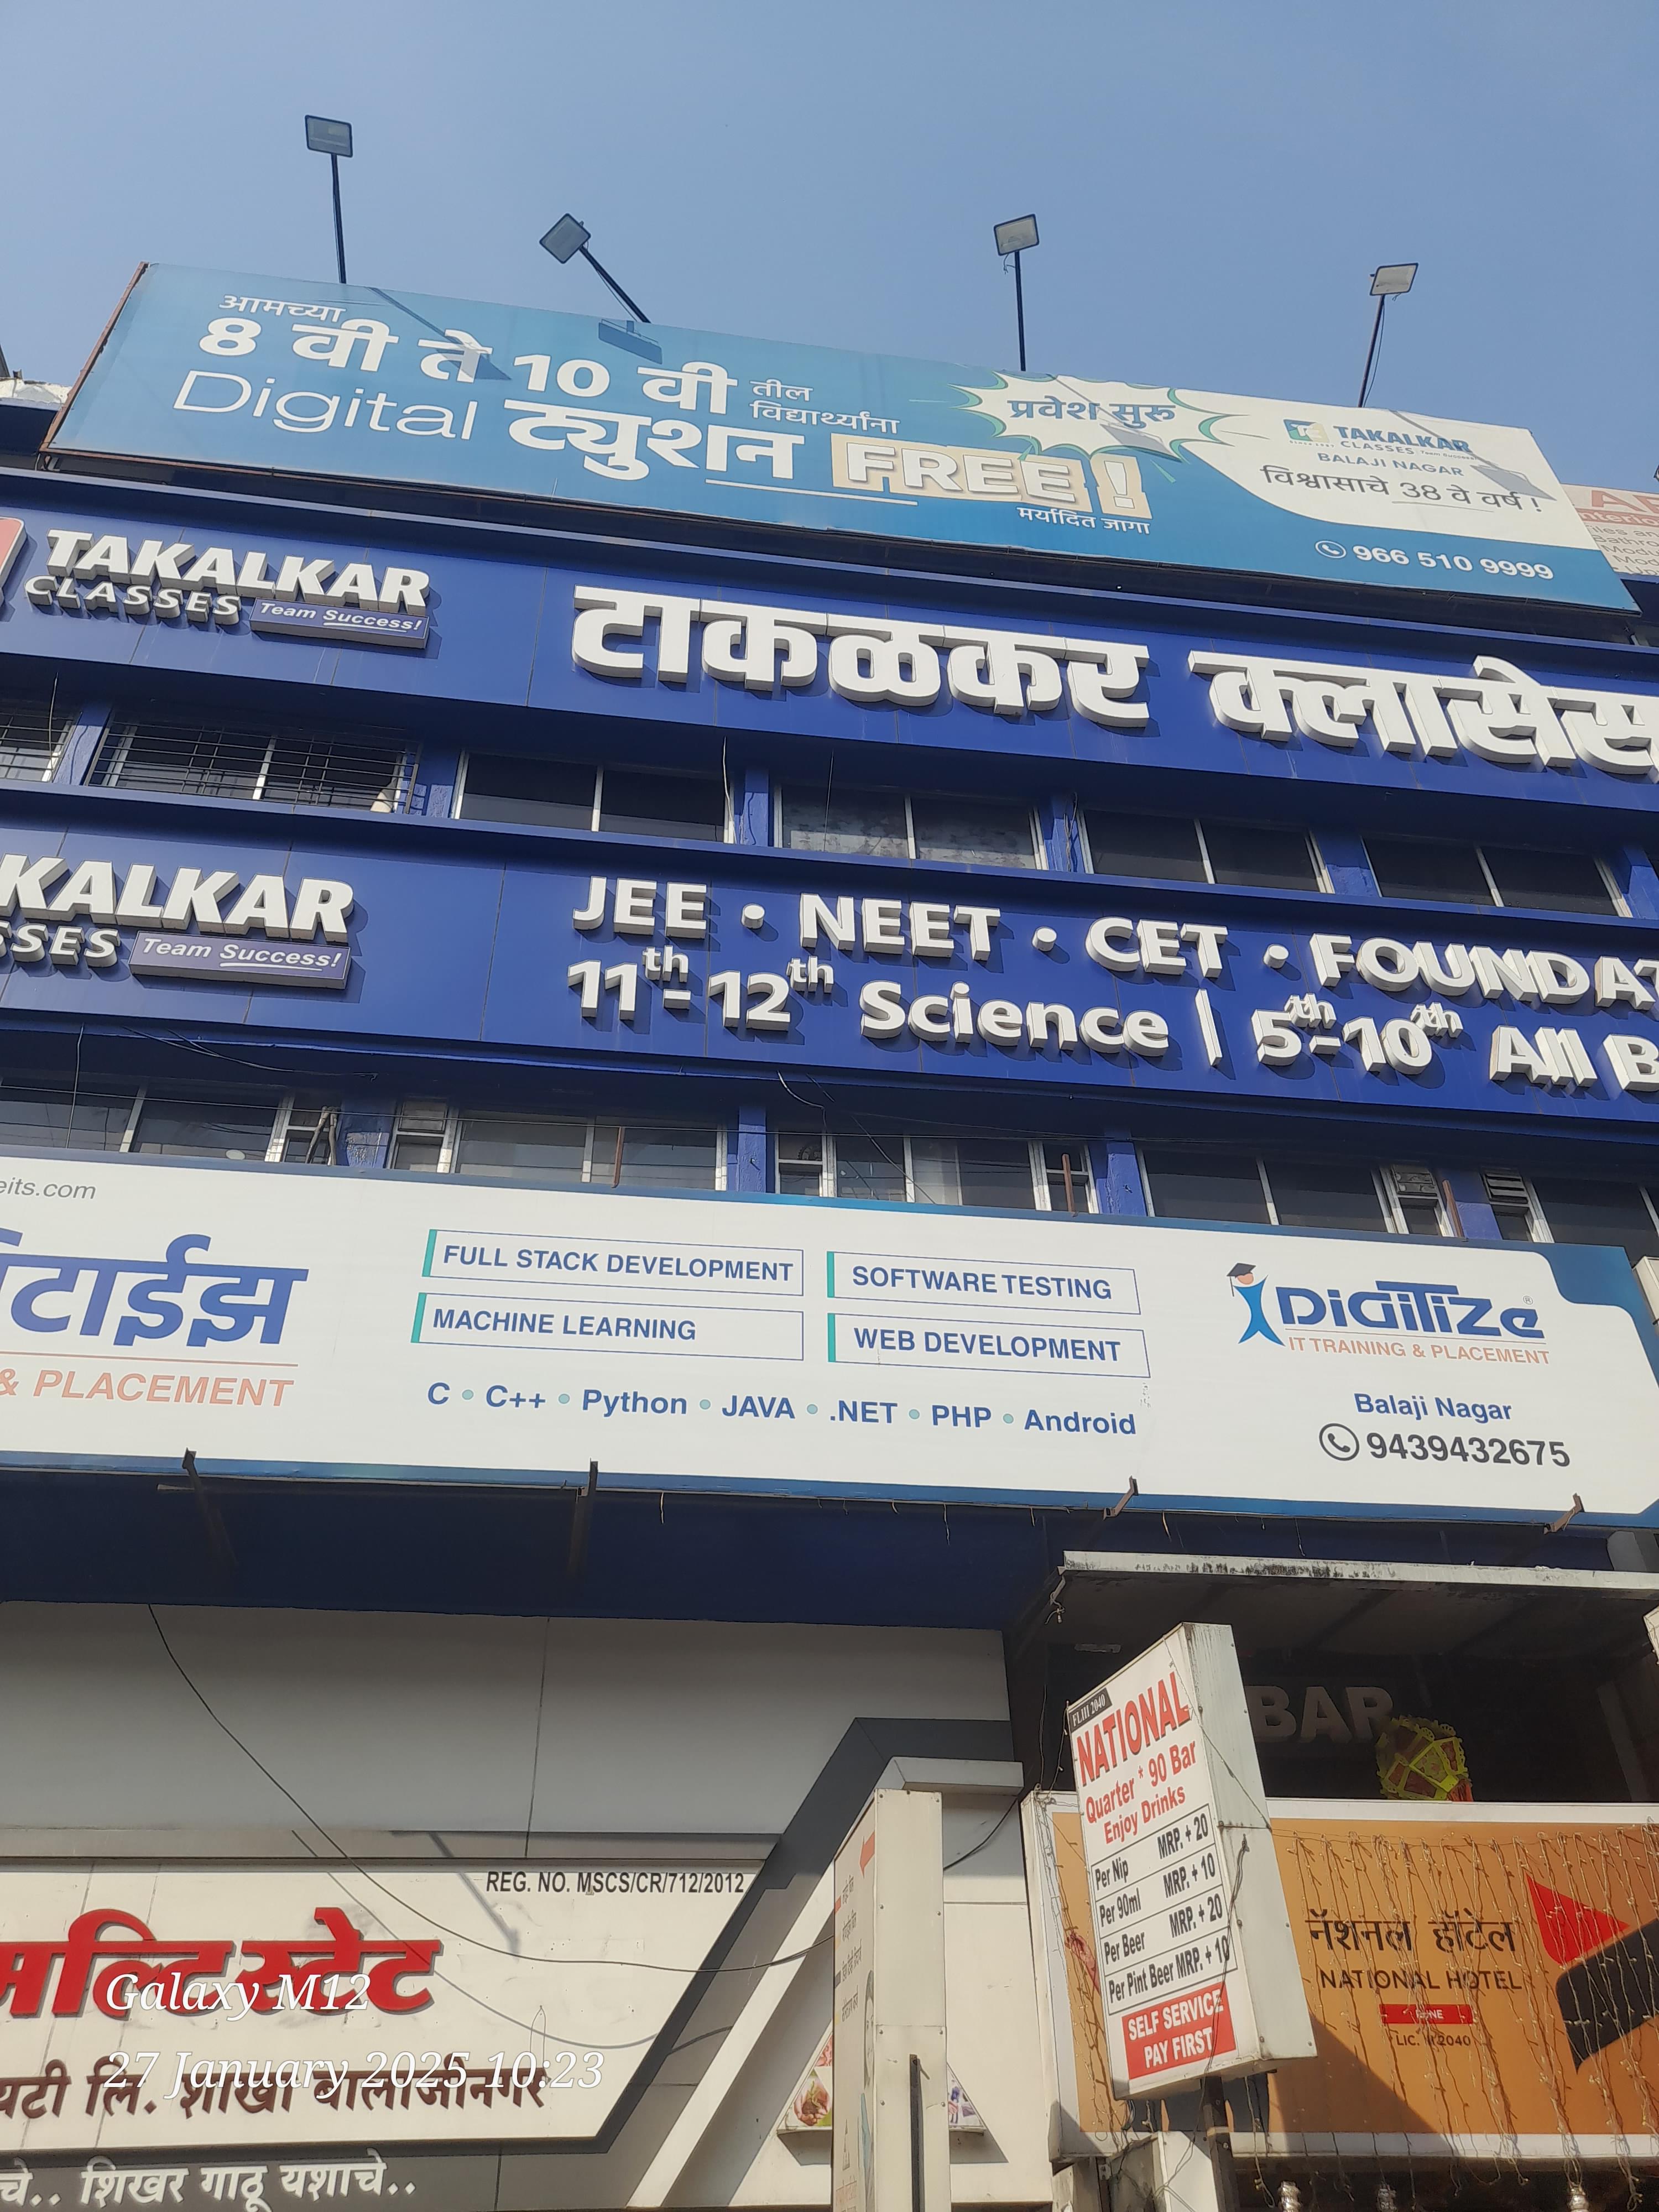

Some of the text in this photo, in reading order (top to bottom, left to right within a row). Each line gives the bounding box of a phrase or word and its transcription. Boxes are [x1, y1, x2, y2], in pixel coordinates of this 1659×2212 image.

[219, 295, 347, 322] आमच्या
[199, 317, 737, 414] 8 वी ते 10 वी
[750, 379, 812, 401] तील
[1008, 396, 1099, 420] प्रवेश
[173, 369, 477, 440] Digital
[504, 399, 805, 481] ट्युशन
[1333, 425, 1473, 453] TAKALKAR
[1318, 453, 1464, 476] BALAJI NAGAR
[1340, 441, 1414, 455] CLASSES
[1260, 465, 1389, 496] विश्वासाचे
[1400, 482, 1441, 500] 38
[1447, 485, 1470, 504] वे
[1477, 490, 1522, 510] वर्ष
[1018, 508, 1149, 534] मर्यादित जागा
[1585, 525, 1628, 535] iles
[46, 529, 429, 614] TAKALKAR
[1353, 545, 1553, 580] 966 510 9999
[24, 575, 240, 625] CLASSES
[260, 602, 422, 631] Team Success!
[572, 584, 1149, 727] टाकळकर
[572, 875, 707, 940] JEE
[800, 893, 1000, 961] NEET
[1085, 916, 1228, 978] CET
[142, 938, 342, 968] Team Success!
[859, 980, 1168, 1057] Science
[1490, 1025, 1597, 1087] All
[444, 1245, 793, 1281] FULL STACK DEVELOPMENT
[853, 1266, 1111, 1300] SOFTWARE TESTING
[433, 1308, 696, 1340] MACHINE LEARNING
[854, 1328, 1120, 1361] WEB DEVELOPMENT
[1288, 1337, 1549, 1365] IT TRAINING & PLACEMENT
[33, 1369, 294, 1407] PLACEMENT
[427, 1383, 1136, 1434] C C++ Python JAVA .NET PHP Android
[1354, 1392, 1511, 1424] Balaji Nagar
[1366, 1432, 1570, 1467] 9439432675
[1090, 1694, 1105, 1713] 2040
[1244, 1685, 1394, 1743] BAR
[1077, 1671, 1190, 1787] NATIONAL
[1086, 1740, 1196, 1823] Quarter 90 Bar
[1104, 1785, 1186, 1844] Enjoy Drinks
[1095, 1868, 1110, 1891] Per
[1112, 1857, 1129, 1883] Nip
[1157, 1827, 1183, 1859] MRP.
[1193, 1813, 1208, 1841] 20
[486, 1872, 744, 1893] REG. NO. MSCS/CR/712/2012
[1099, 1905, 1115, 1927] Per
[1117, 1887, 1141, 1919] 90ml
[1163, 1866, 1190, 1898] MRP.
[1201, 1853, 1215, 1880] 10
[1104, 1942, 1119, 1964] Per
[1122, 1932, 1145, 1957] Beer
[1169, 1906, 1196, 1938] MRP.
[1207, 1893, 1223, 1922] 20
[1109, 1980, 1124, 2003] Per
[1127, 1969, 1148, 1996] Pint
[1149, 1963, 1173, 1988] Beer
[1175, 1947, 1203, 1979] MRP.
[1215, 1936, 1229, 1963] 10
[1320, 1970, 1522, 1990] NATIONAL HOTEL
[1128, 1989, 1224, 2041] SELF SERVICE
[1144, 2027, 1213, 2068] PAY FIRST
[1396, 2035, 1420, 2046] LIC.
[80, 2156, 190, 2208] शिखर
